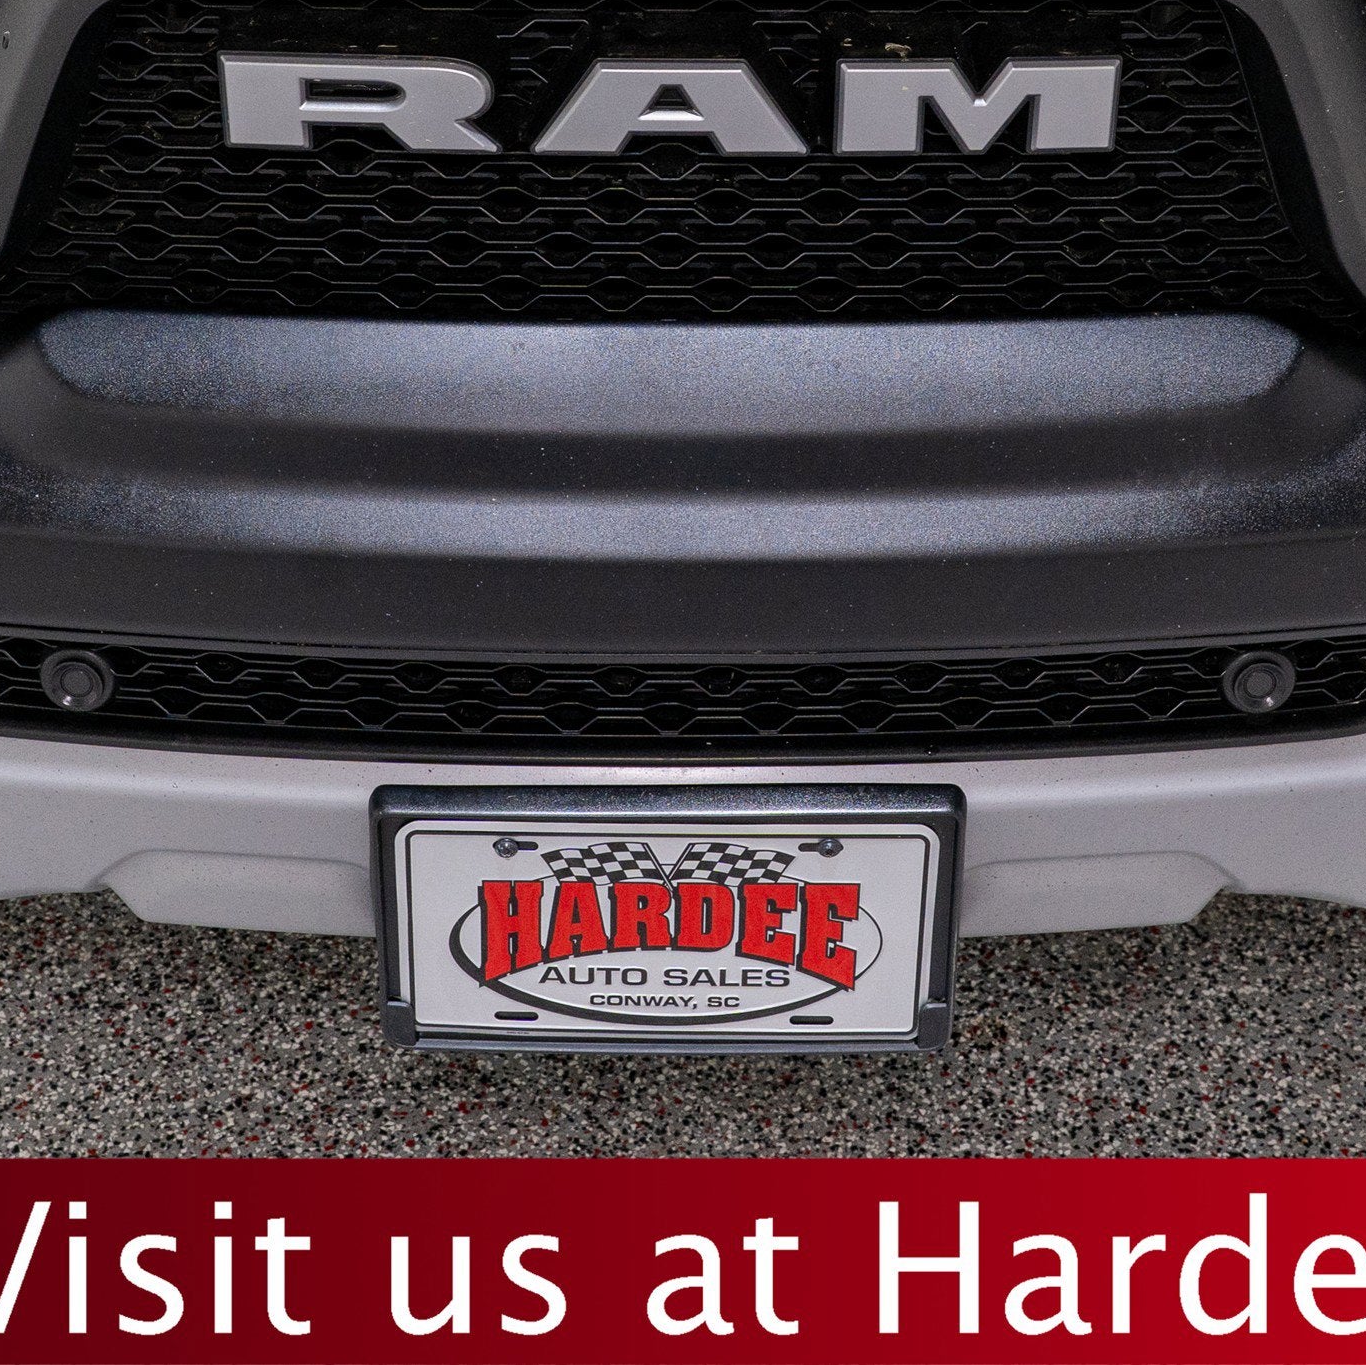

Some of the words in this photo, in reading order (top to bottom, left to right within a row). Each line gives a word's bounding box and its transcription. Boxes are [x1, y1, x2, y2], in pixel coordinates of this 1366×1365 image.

[218, 50, 1123, 155] RAM
[478, 879, 862, 991] HARDEE
[538, 966, 648, 986] AUTO
[663, 968, 790, 987] SALES
[589, 994, 698, 1010] CONWAY,
[707, 996, 741, 1008] SC
